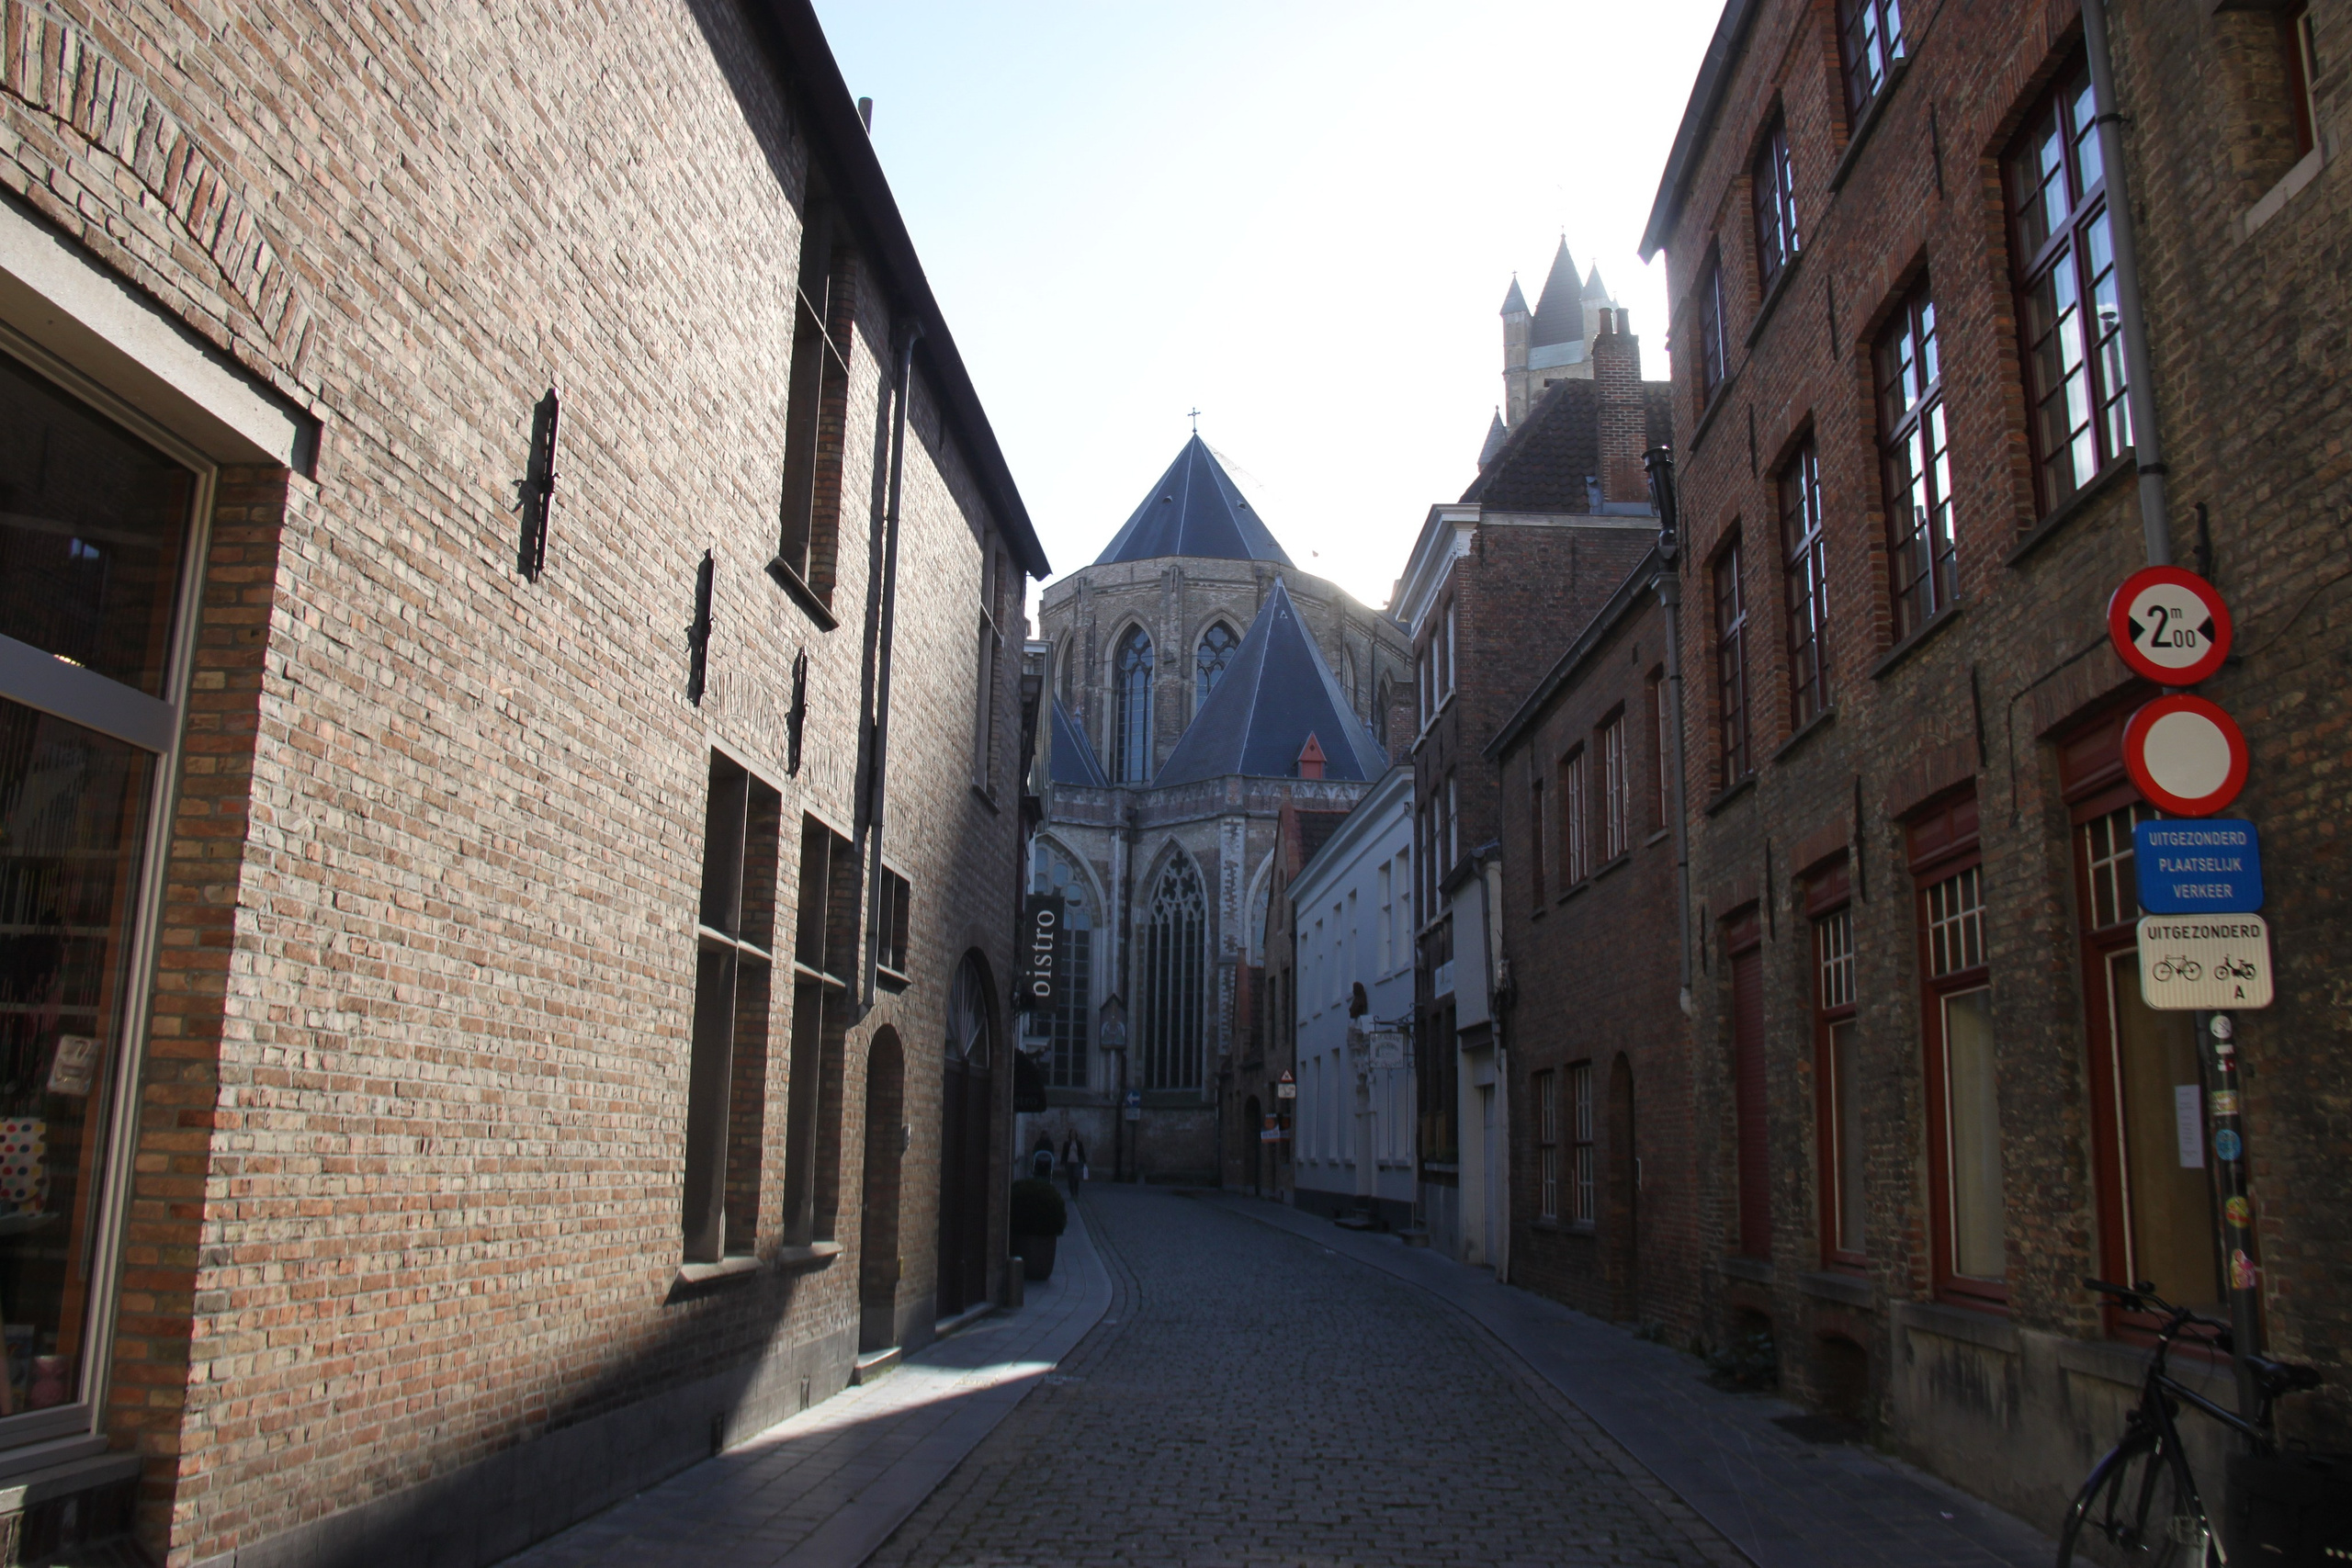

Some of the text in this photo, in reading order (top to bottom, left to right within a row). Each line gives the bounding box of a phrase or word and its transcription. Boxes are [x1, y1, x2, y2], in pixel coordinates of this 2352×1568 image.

[2148, 831, 2247, 846] UITGEZONDERD
[2158, 858, 2243, 872] PLAATSELIJK
[2172, 884, 2233, 898] VERKEER
[2147, 924, 2260, 941] UITGEZONDERD
[2233, 986, 2245, 998] A
